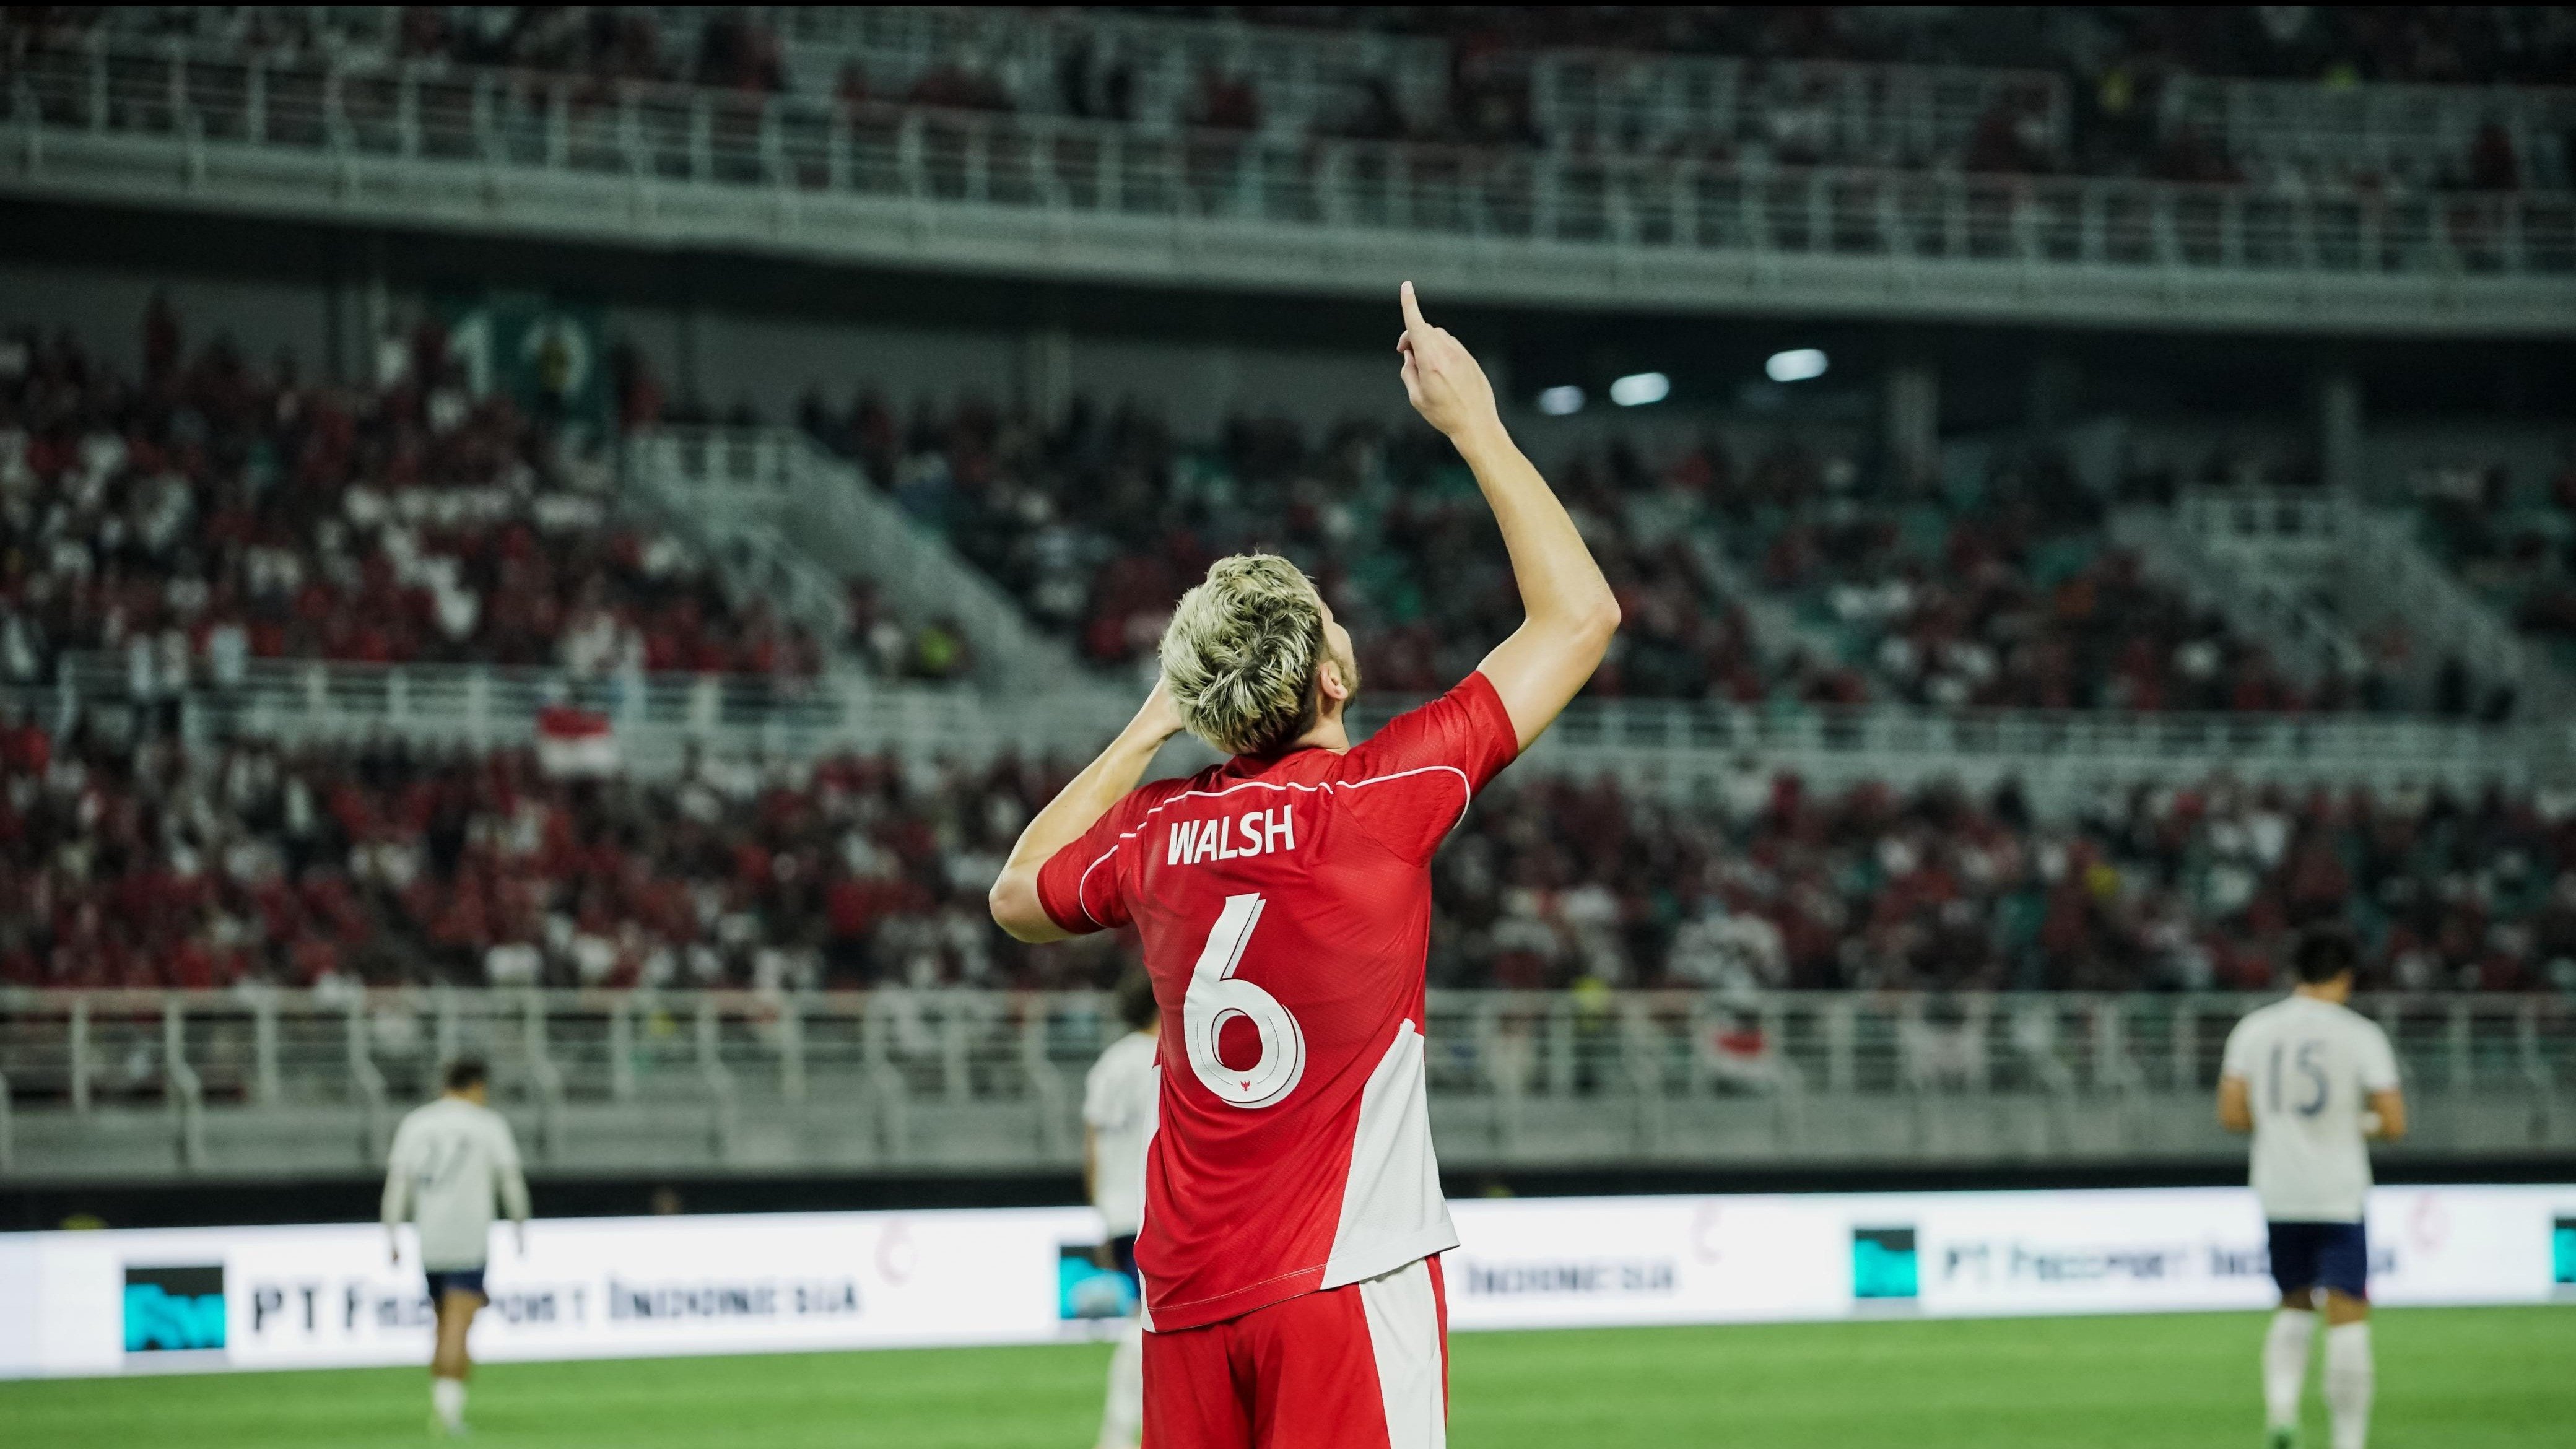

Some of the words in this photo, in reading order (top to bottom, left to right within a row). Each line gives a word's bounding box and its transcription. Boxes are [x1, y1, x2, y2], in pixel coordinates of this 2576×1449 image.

[1167, 804, 1295, 865] WALSH
[1183, 892, 1306, 1109] 6
[2267, 1039, 2330, 1120] 15
[251, 1279, 322, 1333] PT
